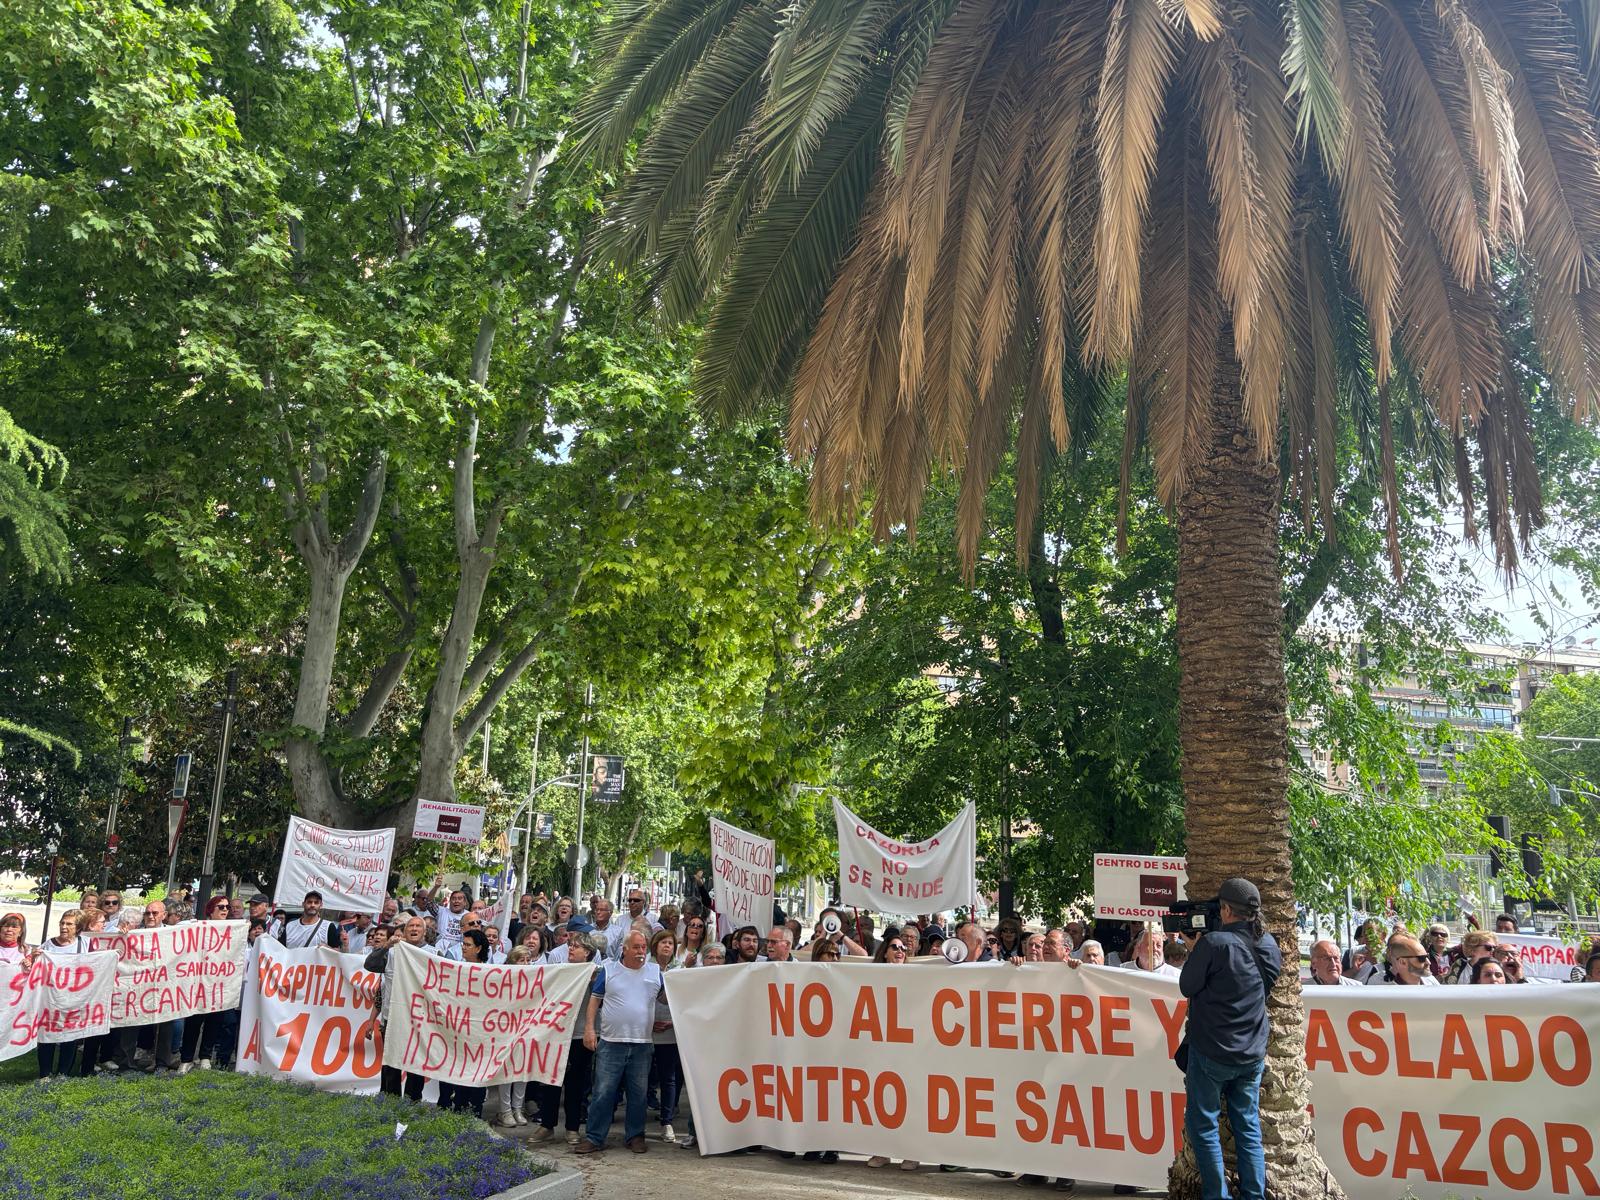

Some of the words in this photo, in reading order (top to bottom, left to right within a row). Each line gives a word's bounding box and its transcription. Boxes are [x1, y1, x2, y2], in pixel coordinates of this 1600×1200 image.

[343, 834, 385, 854] SALUD
[414, 830, 442, 839] CENTRO
[443, 833, 466, 843] SALUD
[855, 824, 940, 856] CAZORLA
[319, 851, 348, 869] CASCO
[881, 857, 908, 876] NO
[1096, 858, 1141, 868] CENTRO
[1144, 861, 1159, 870] DE
[1162, 862, 1189, 871] SAL
[305, 875, 325, 888] NO
[330, 877, 340, 892] A
[848, 864, 872, 889] SE
[1100, 906, 1114, 915] EN
[1118, 907, 1155, 917] CASCO
[133, 965, 168, 984] UNA
[422, 958, 545, 1001] DELEGADA
[110, 982, 224, 1021] ERCANA!!
[410, 992, 471, 1036] ELENA
[768, 983, 832, 1038] NO
[849, 987, 913, 1043] AL
[931, 989, 1134, 1057] CIERRE
[1151, 998, 1188, 1060] Y
[1304, 1009, 1591, 1086] ASLADO
[717, 1064, 908, 1130] CENTRO
[927, 1074, 996, 1138] DE
